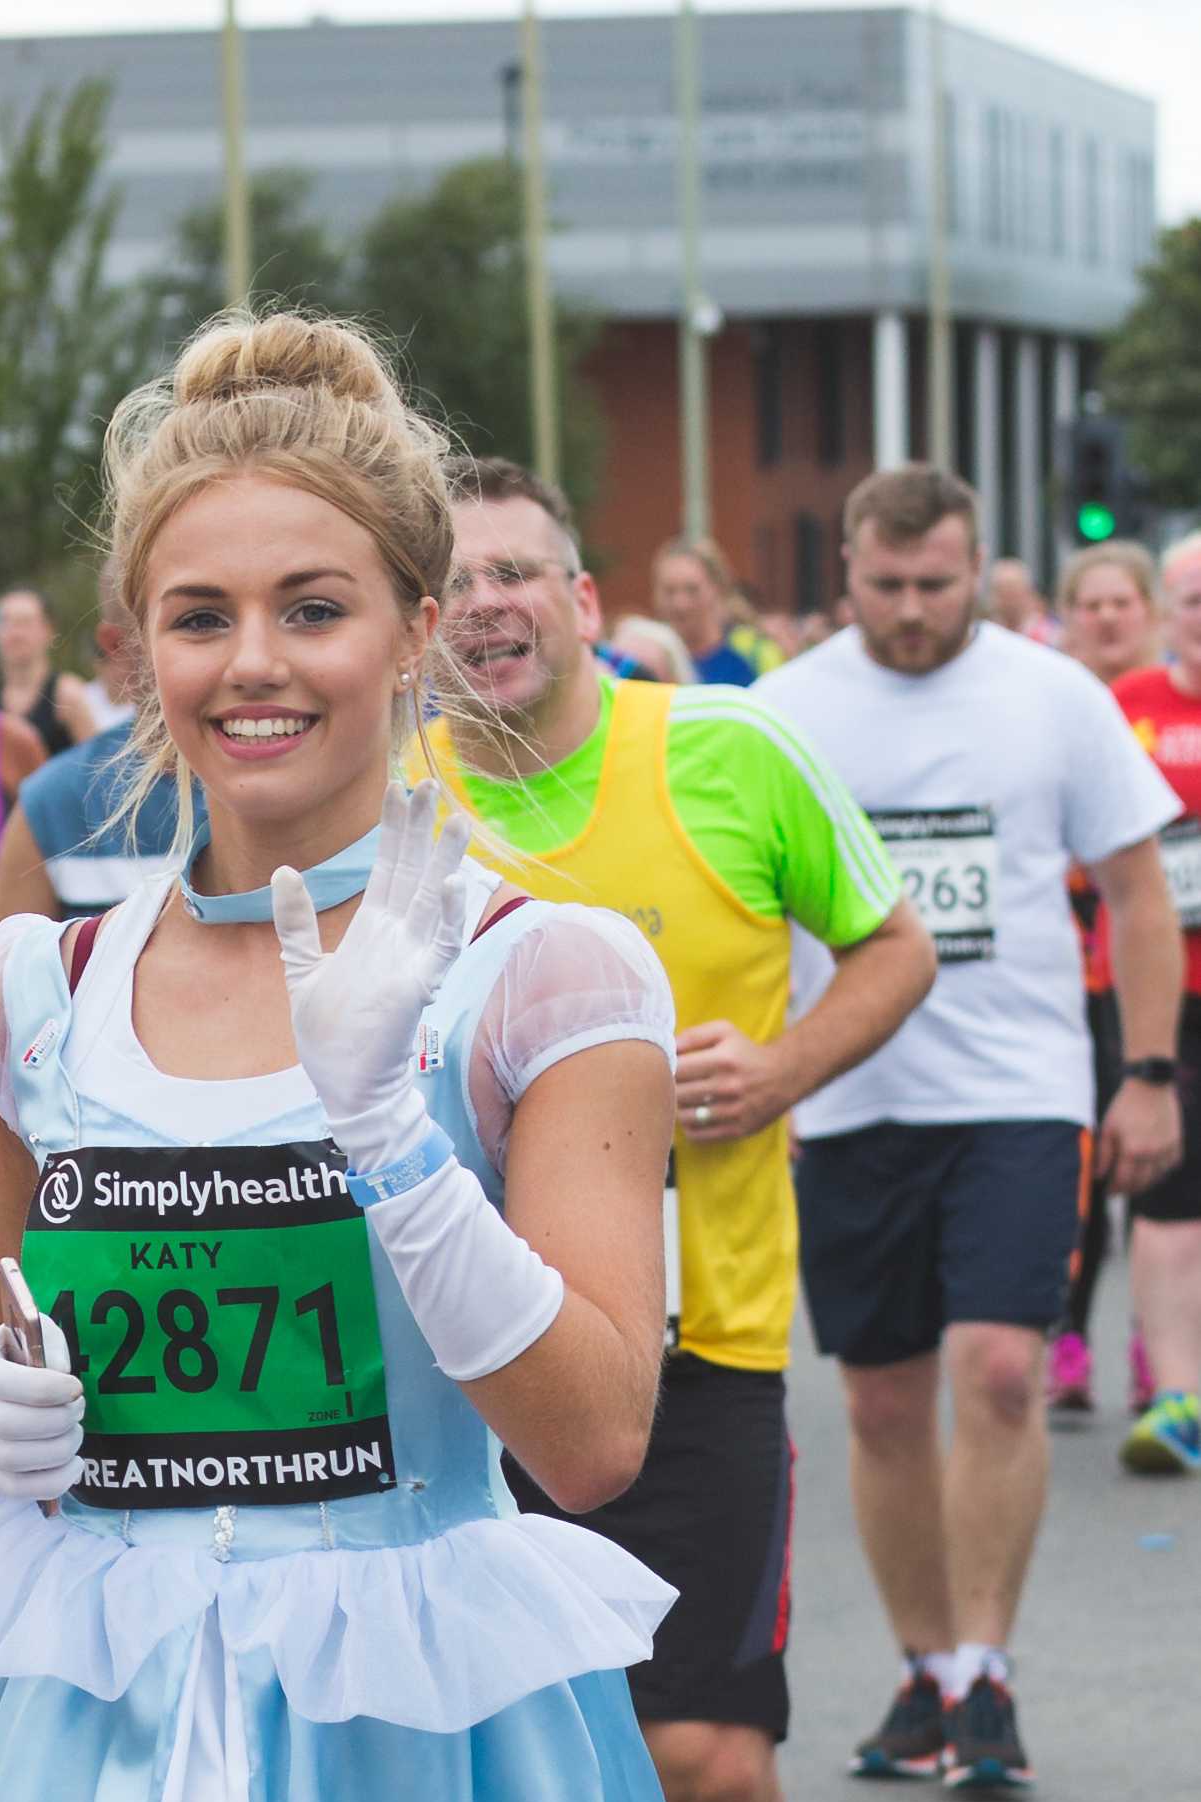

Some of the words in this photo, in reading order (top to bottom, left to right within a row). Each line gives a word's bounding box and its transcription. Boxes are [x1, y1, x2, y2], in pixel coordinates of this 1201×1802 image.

[94, 1162, 347, 1216] Simplyhealth
[130, 1241, 223, 1270] KATY
[47, 1281, 346, 1395] 42871
[307, 1410, 341, 1422] ZONE
[72, 1441, 383, 1489] REATNORTHRUN
